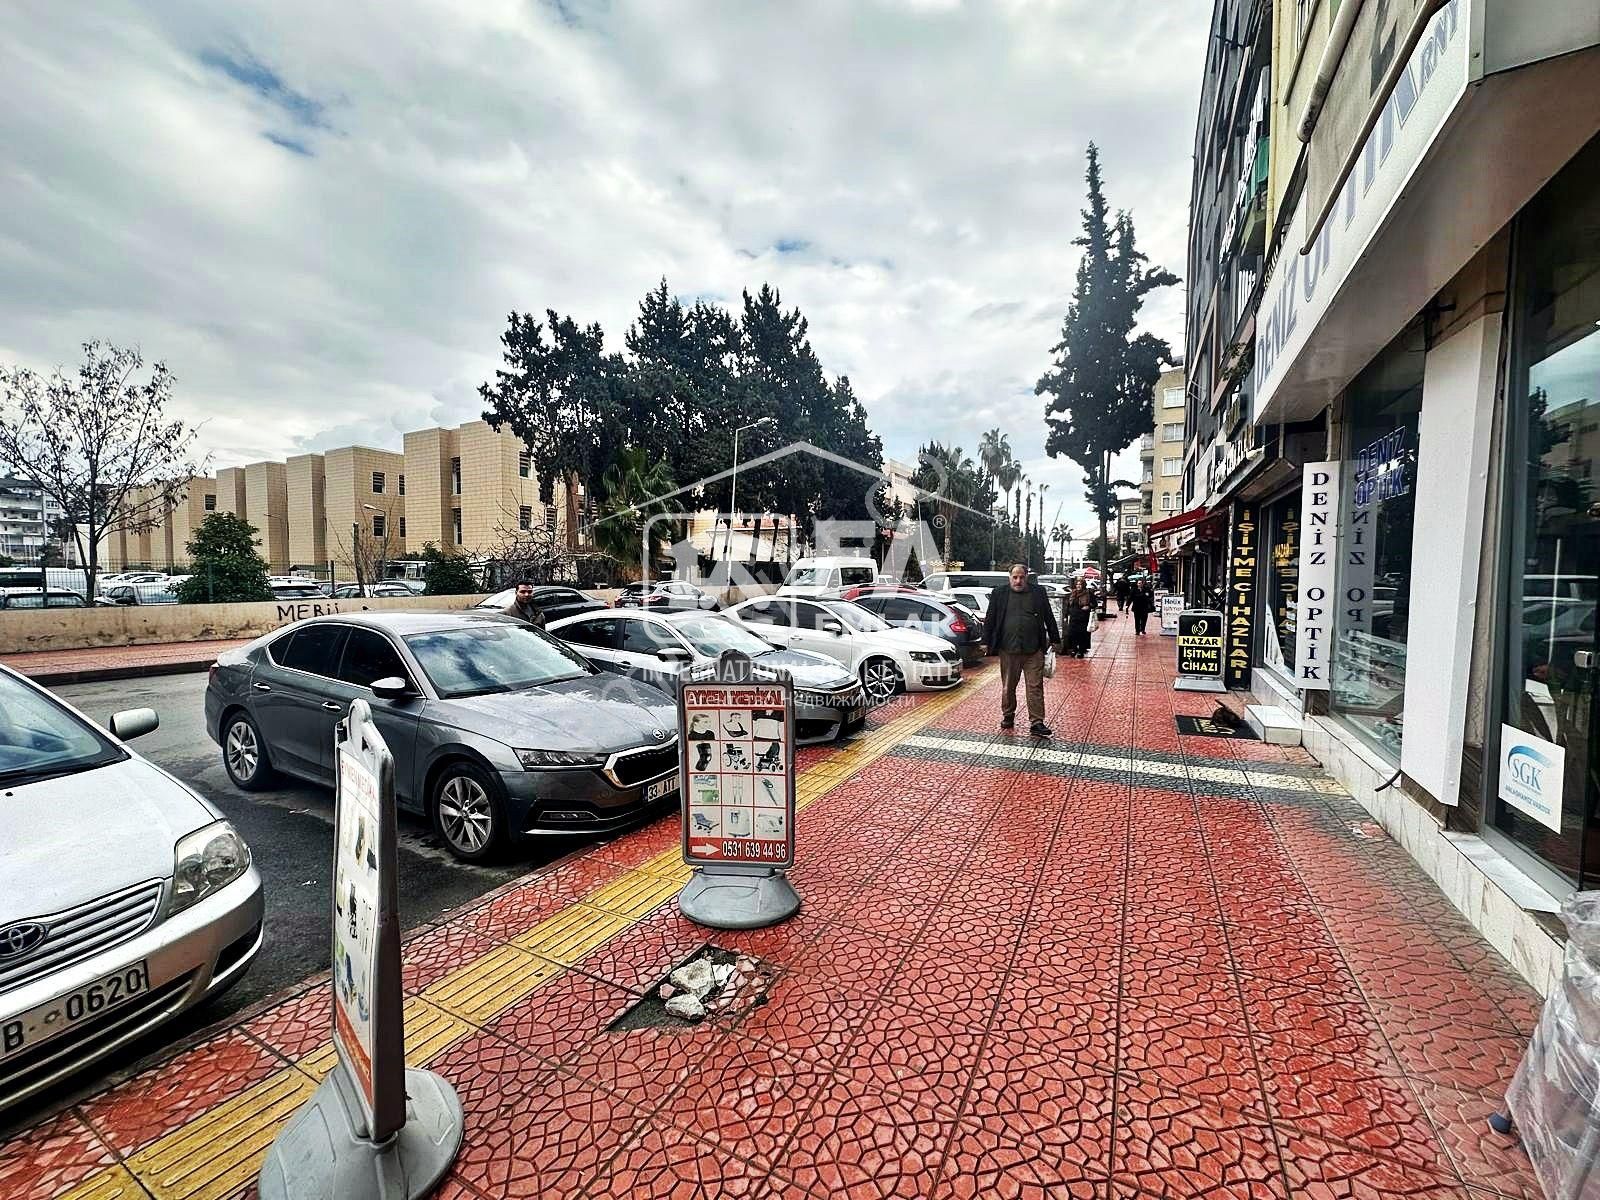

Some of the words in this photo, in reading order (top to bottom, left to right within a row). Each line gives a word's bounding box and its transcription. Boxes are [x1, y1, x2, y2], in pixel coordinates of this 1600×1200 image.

[1309, 472, 1330, 565] DENİZ
[1182, 637, 1218, 645] NAZAR
[1303, 587, 1325, 680] OPTİK
[1182, 660, 1217, 671] CİHAZI
[1183, 647, 1217, 660] İŞİTME
[1512, 758, 1542, 792] SGK
[722, 841, 742, 857] 0531
[745, 842, 760, 857] 639
[763, 843, 774, 858] 44
[775, 843, 786, 859] 96
[65, 968, 143, 1021] 0620
